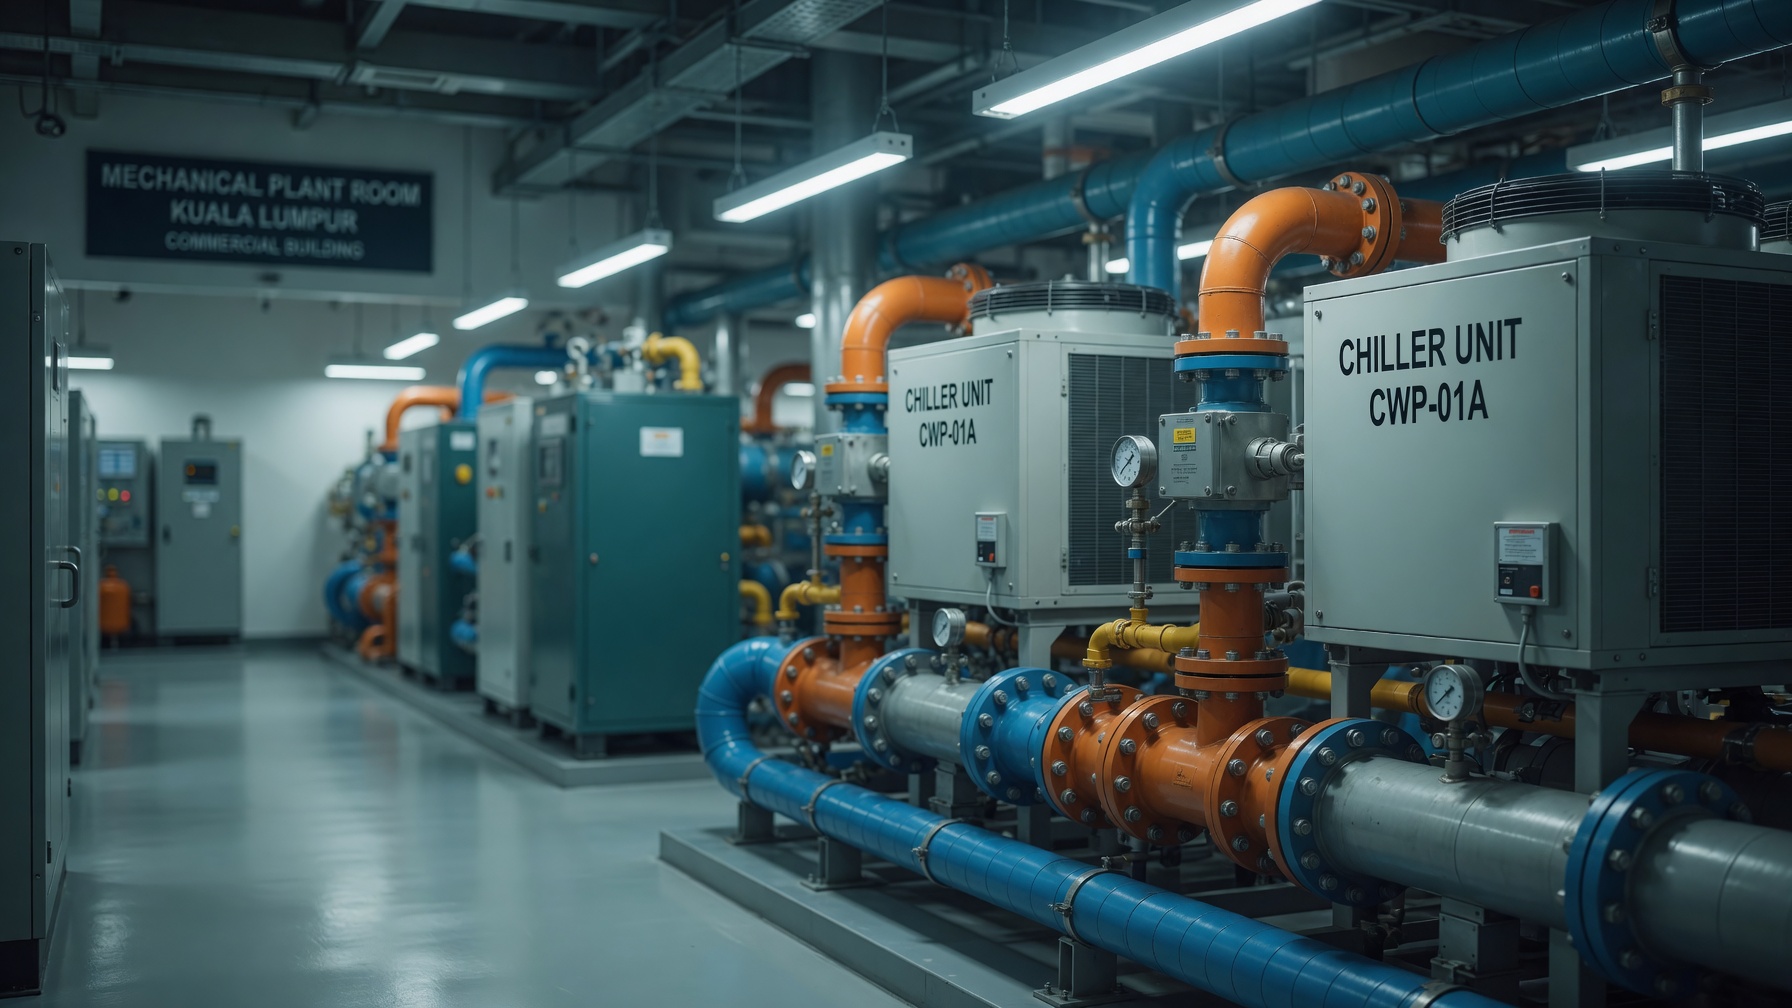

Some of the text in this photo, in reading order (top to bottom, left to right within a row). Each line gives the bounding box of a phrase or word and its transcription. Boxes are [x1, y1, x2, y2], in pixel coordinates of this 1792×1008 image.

[101, 163, 422, 206] MECHANICAL PLANT ROOM
[170, 200, 358, 233] KUALA LUMPUR
[164, 231, 365, 260] COMMERCIAL BUILDING
[1339, 317, 1522, 376] CHILLER UNIT
[906, 378, 993, 413] CHILLER UNIT
[1369, 379, 1489, 427] CWP-01A
[919, 418, 977, 448] CWP-01A
